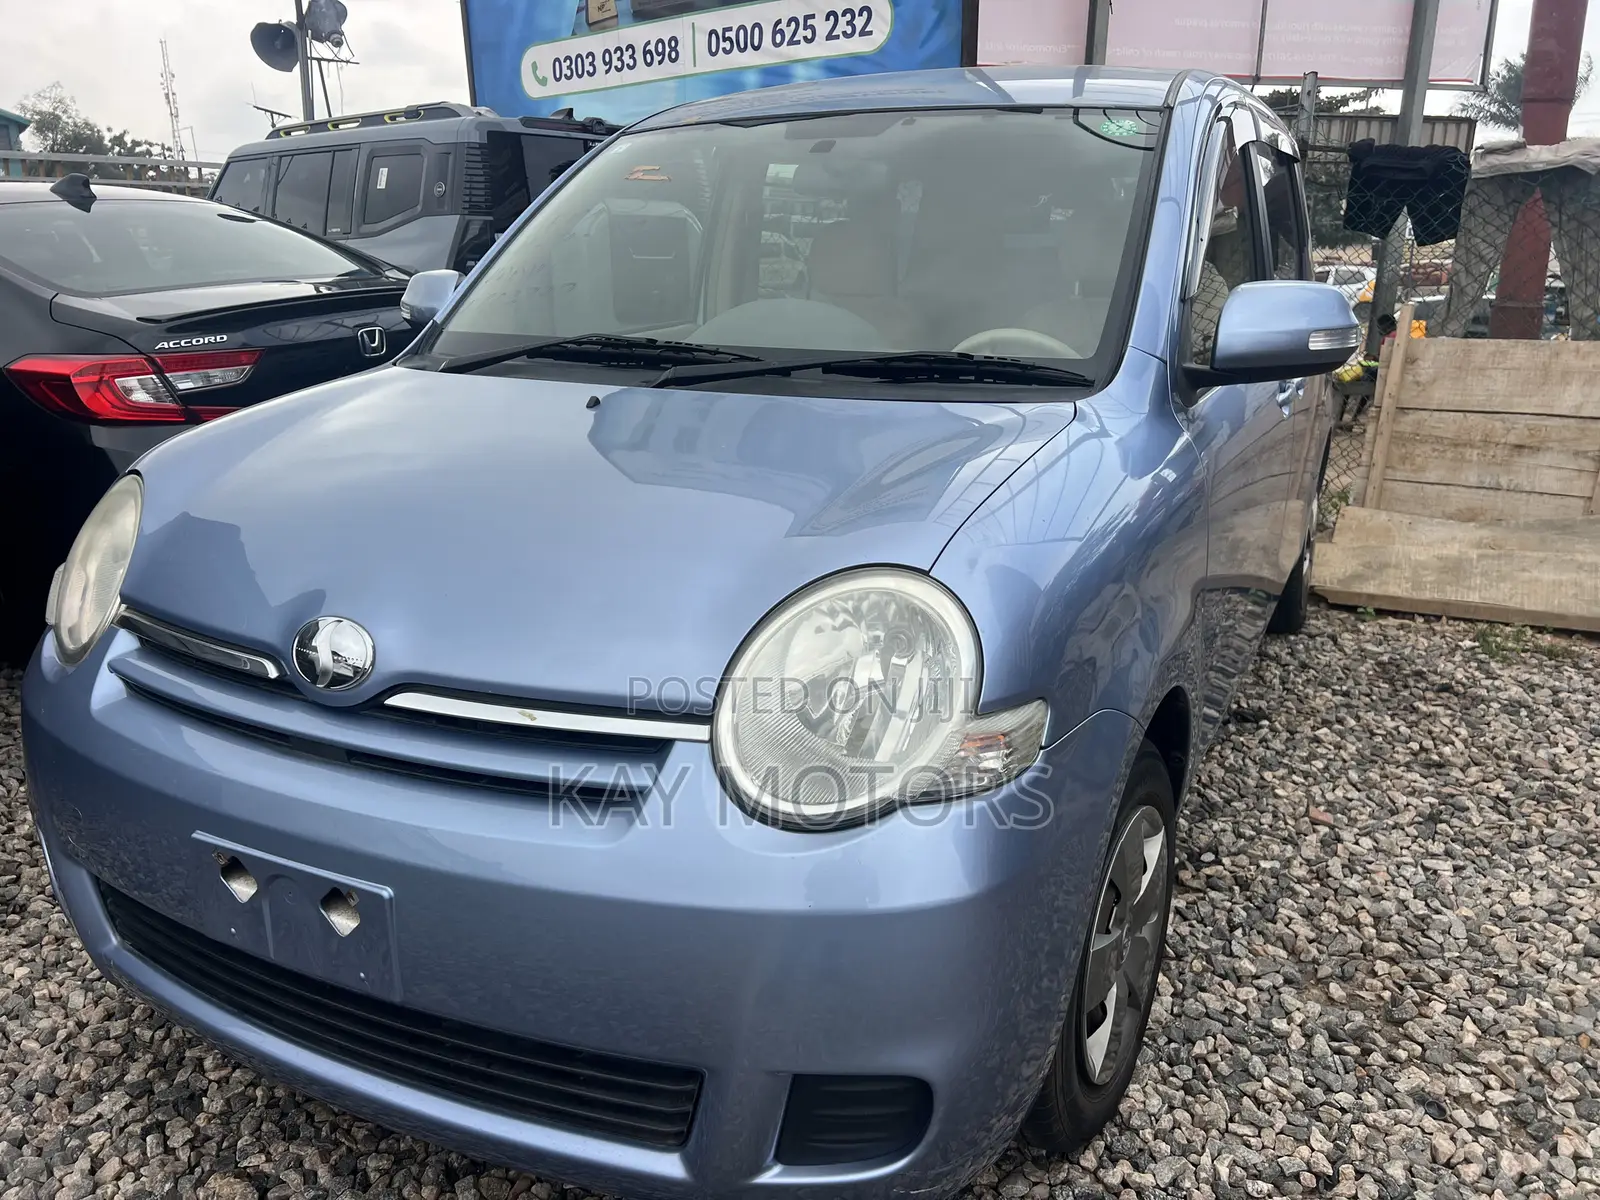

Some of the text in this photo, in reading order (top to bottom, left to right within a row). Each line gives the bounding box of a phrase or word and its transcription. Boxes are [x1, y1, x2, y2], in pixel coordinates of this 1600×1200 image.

[707, 5, 873, 57] 0500 625 232
[552, 35, 680, 82] 0303 933 698
[154, 334, 228, 350] ACCORD
